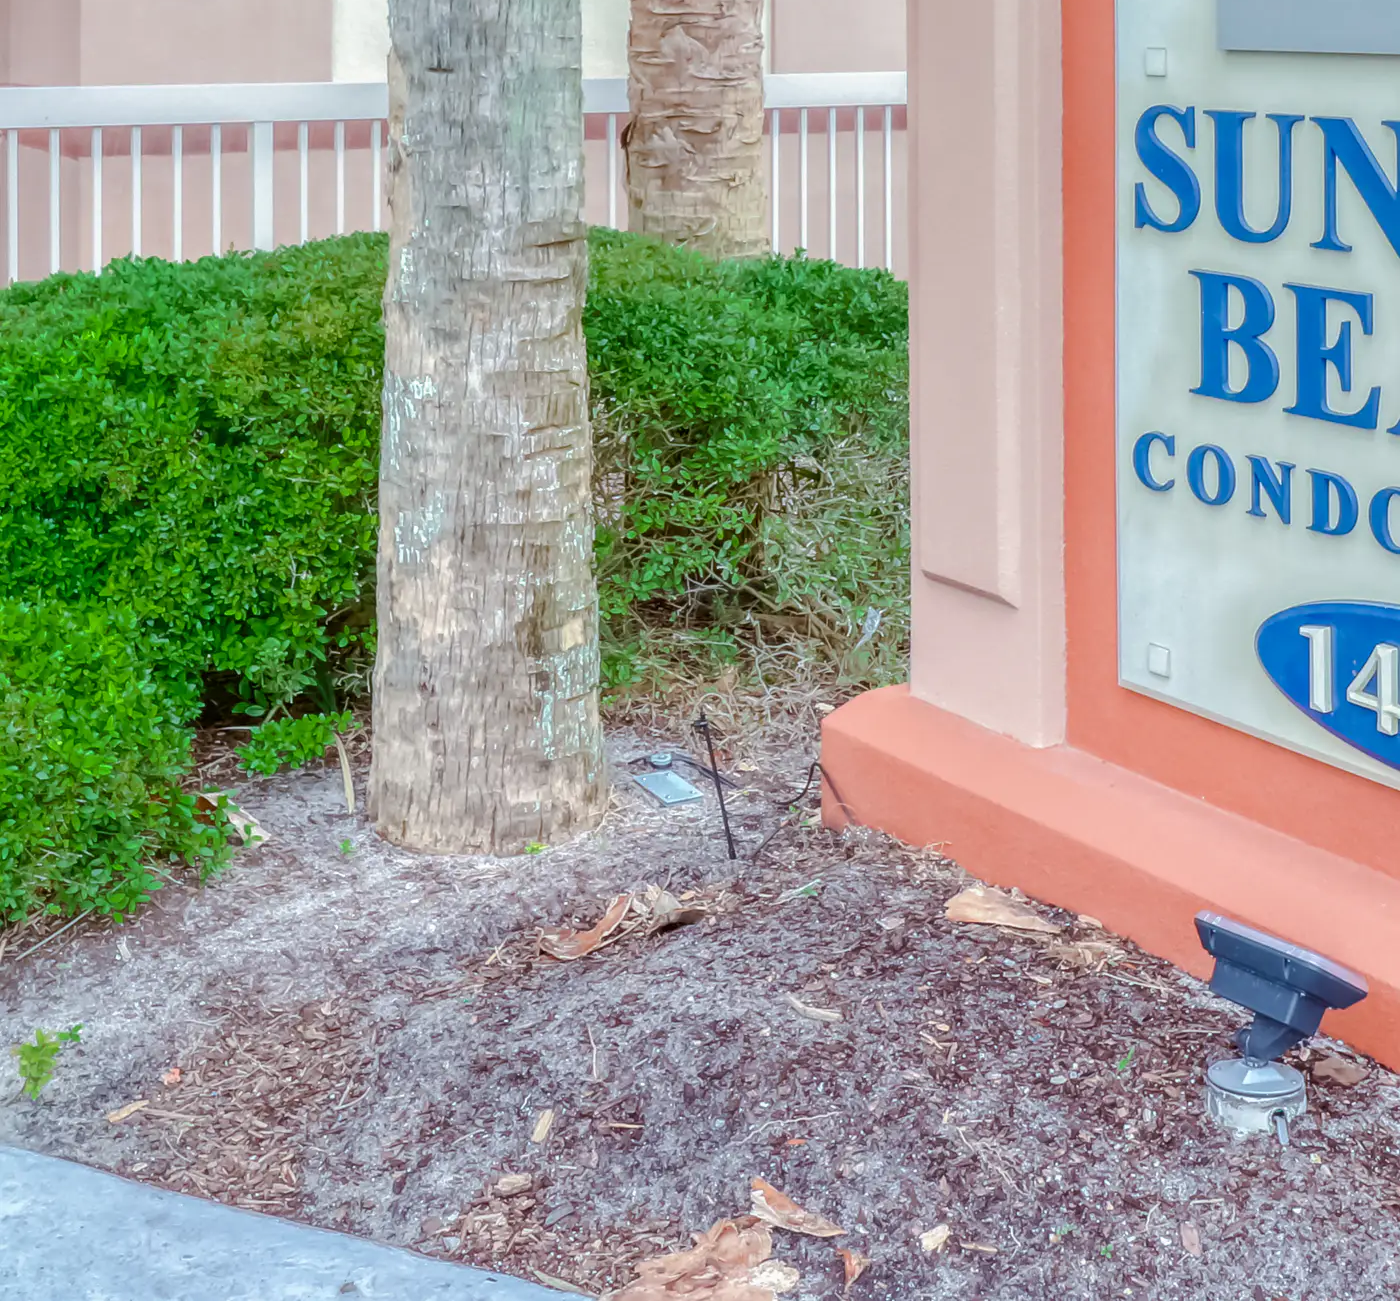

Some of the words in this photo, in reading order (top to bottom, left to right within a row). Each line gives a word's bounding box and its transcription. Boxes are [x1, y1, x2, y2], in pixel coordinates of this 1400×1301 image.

[1134, 104, 1400, 259] SUN
[1188, 268, 1400, 436] BE
[1298, 624, 1400, 736] 14
